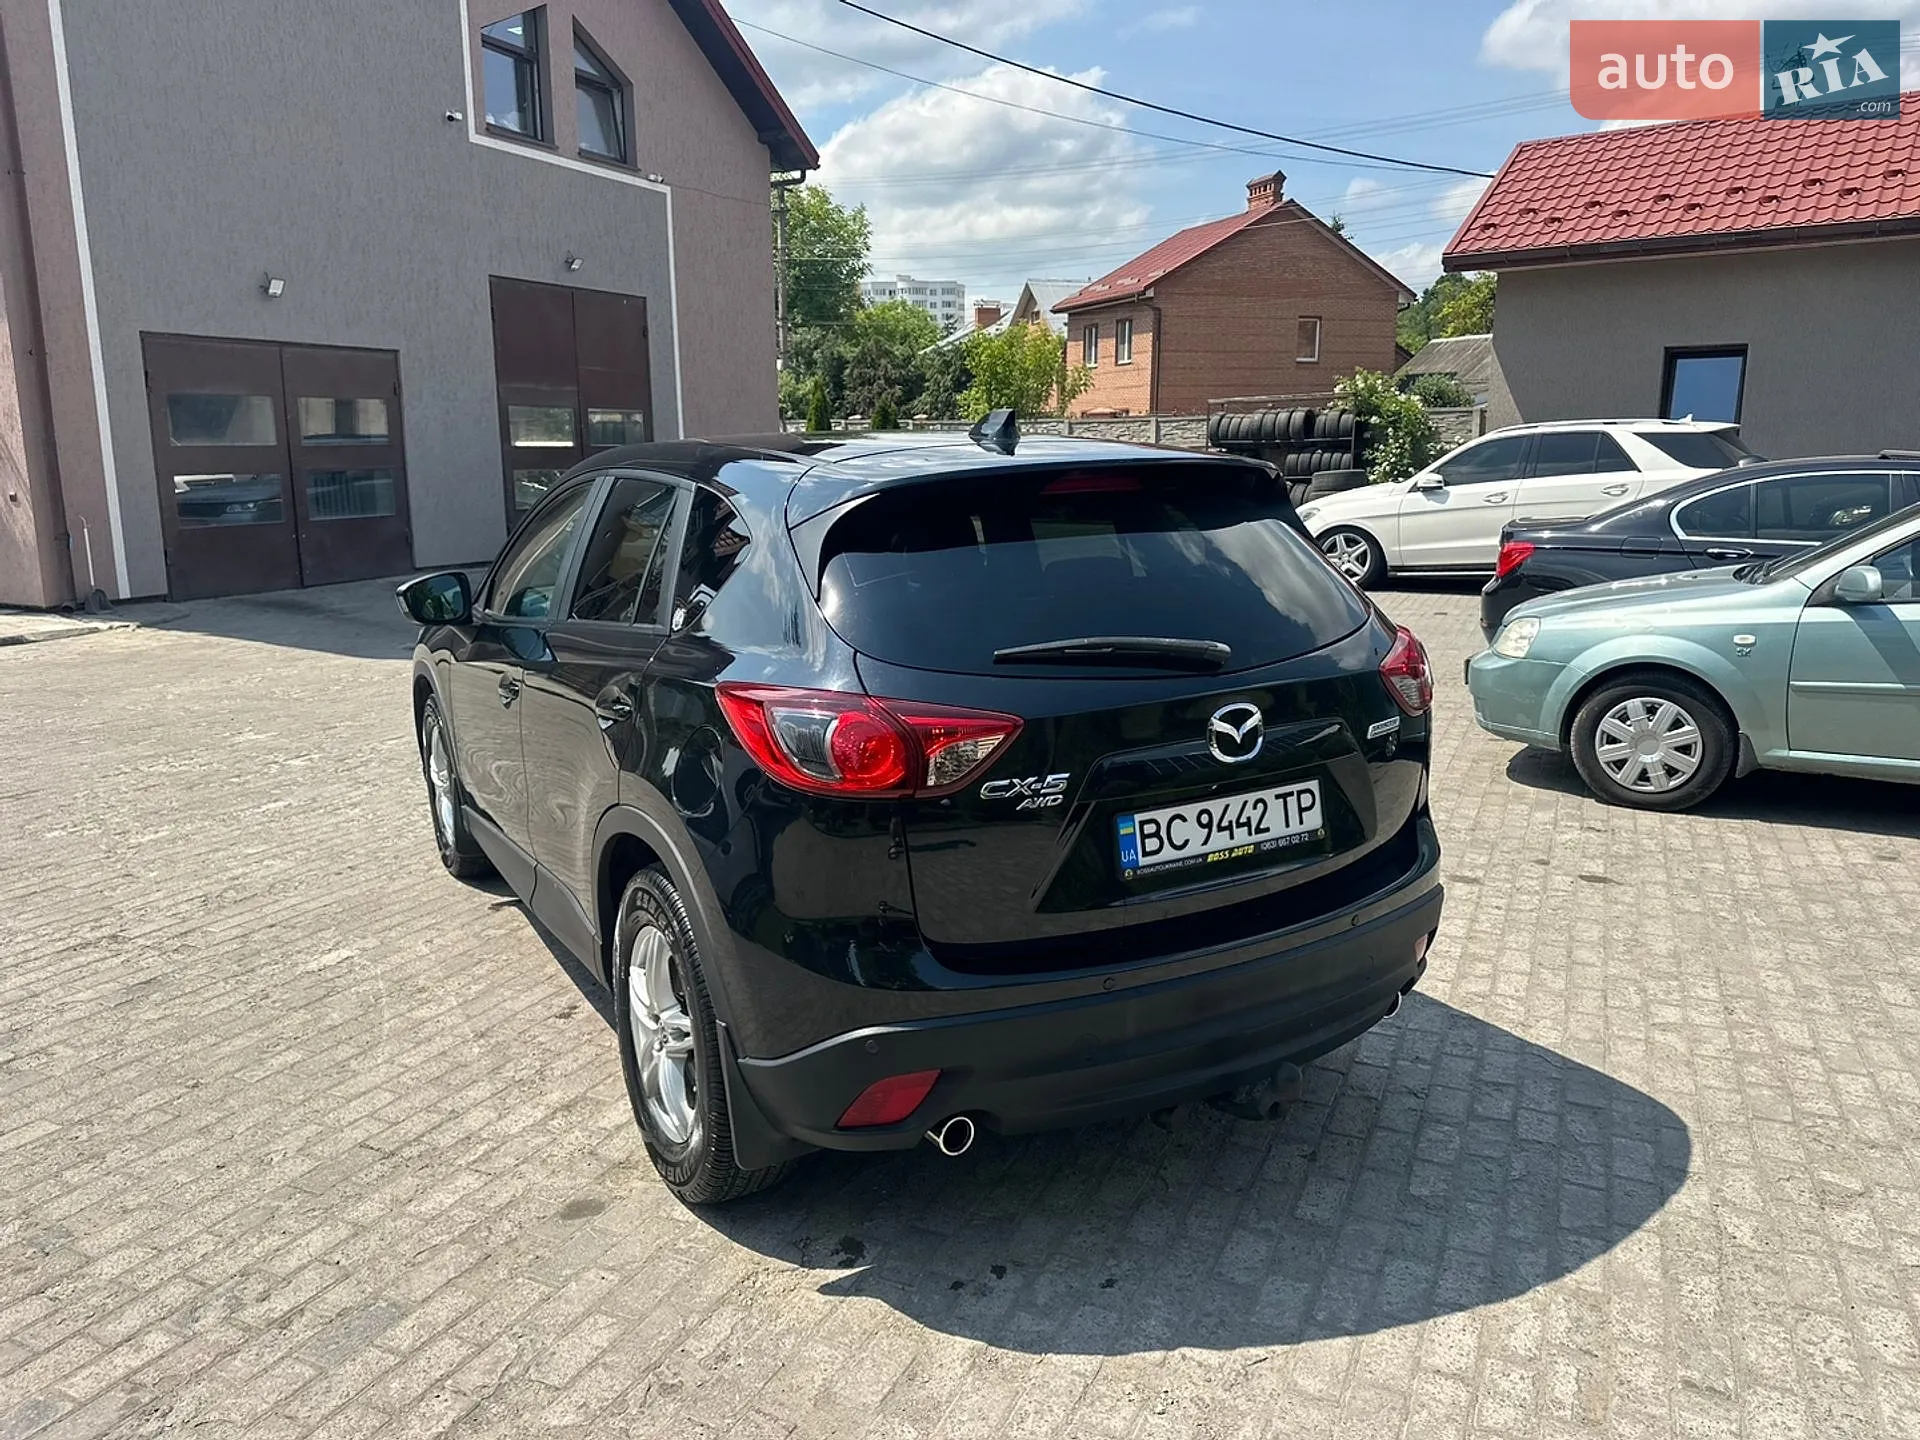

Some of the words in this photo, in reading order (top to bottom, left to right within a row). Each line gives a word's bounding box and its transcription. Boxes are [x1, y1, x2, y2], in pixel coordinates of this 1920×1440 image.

[980, 773, 1070, 799] CX-5
[1016, 794, 1064, 810] AWD
[1138, 813, 1190, 858] BC
[1196, 798, 1271, 847] 9442
[1275, 788, 1317, 829] TP
[1121, 848, 1137, 862] UA
